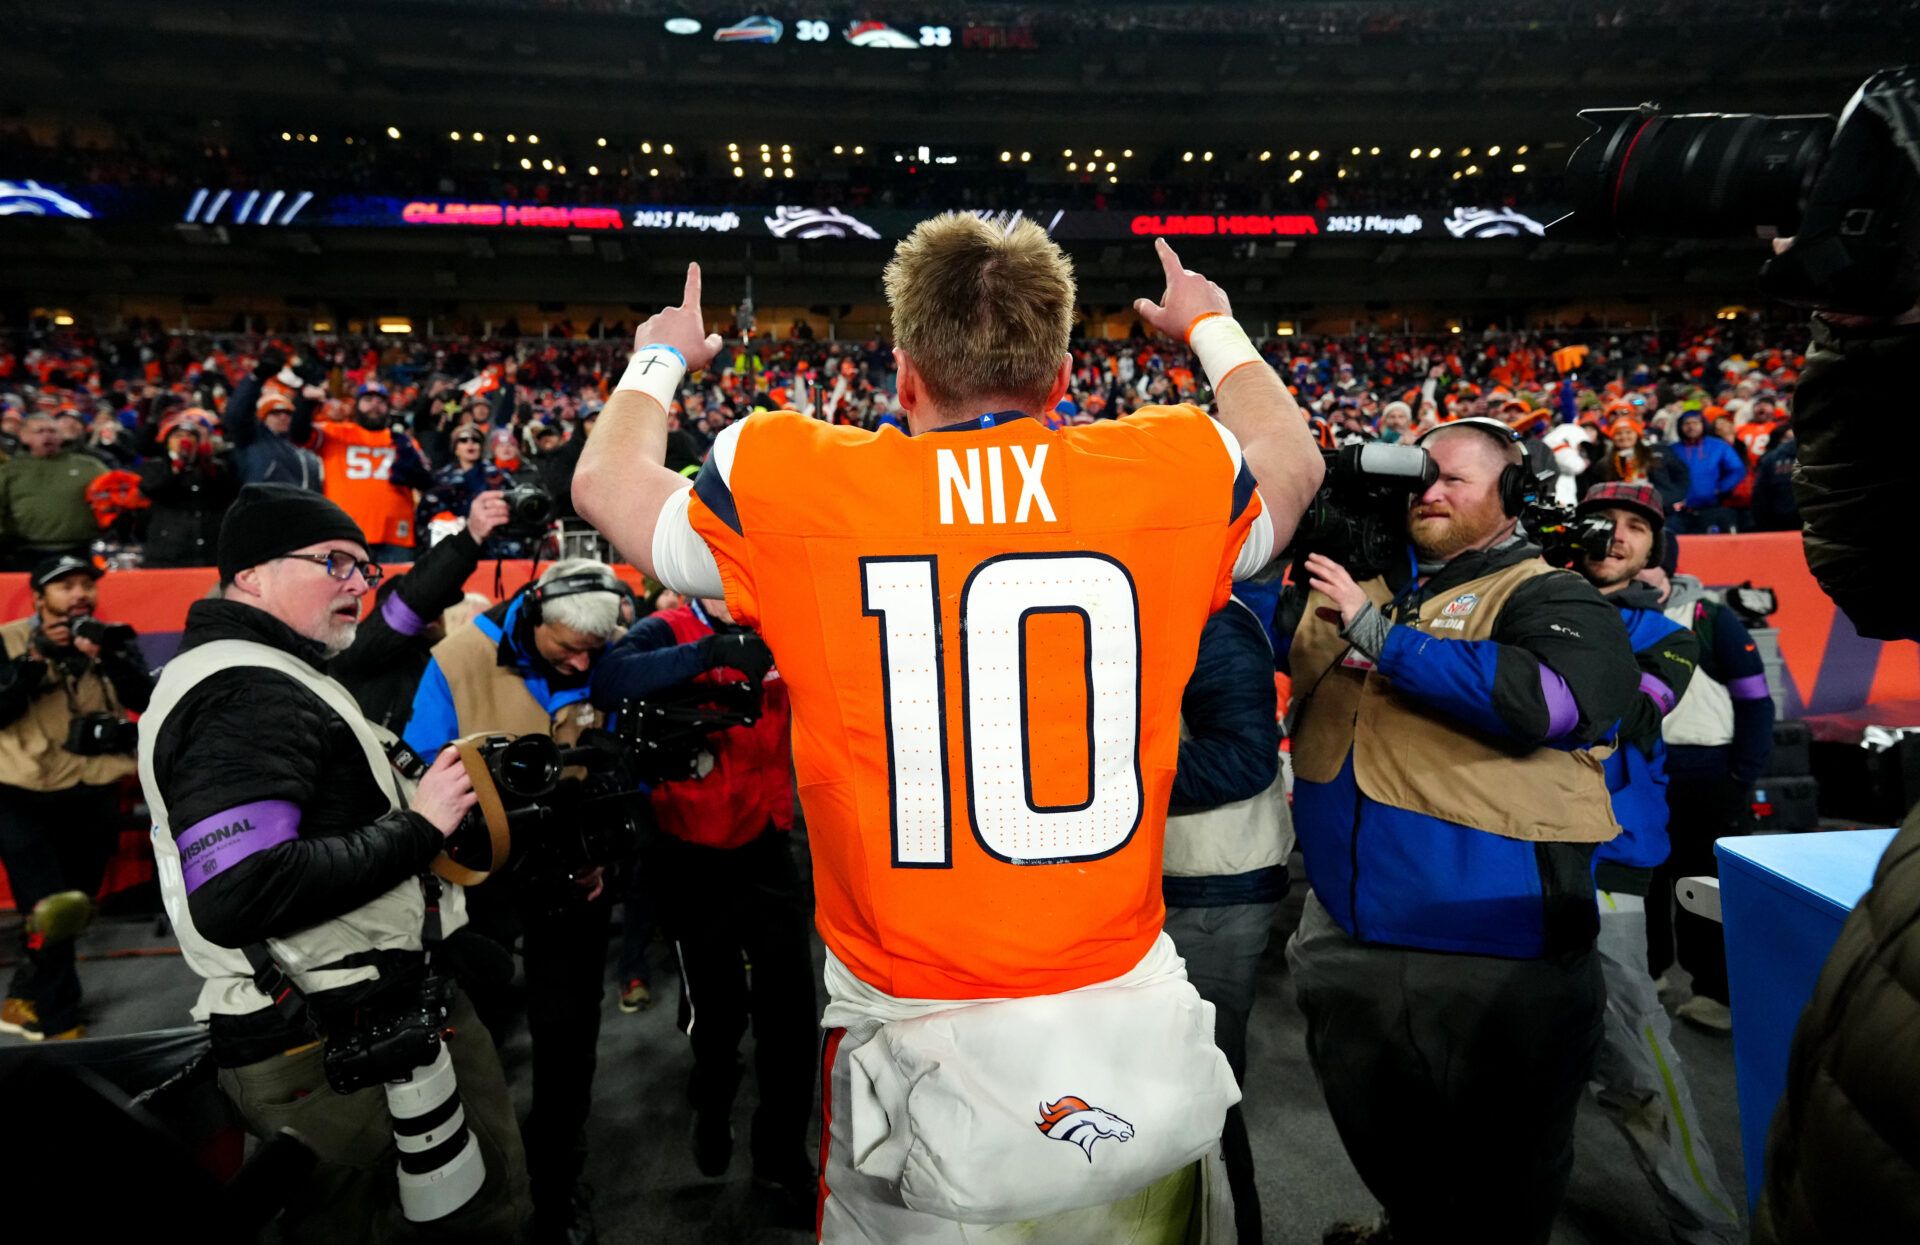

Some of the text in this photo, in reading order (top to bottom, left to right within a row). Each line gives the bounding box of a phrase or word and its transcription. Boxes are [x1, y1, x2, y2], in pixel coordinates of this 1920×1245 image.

[796, 20, 830, 42] 30
[919, 26, 951, 47] 33
[633, 211, 740, 231] 2025 Playoffs
[1327, 214, 1423, 234] 2025 Playoffs
[345, 445, 396, 480] 57
[936, 444, 1057, 525] NIX
[858, 550, 1145, 869] 10
